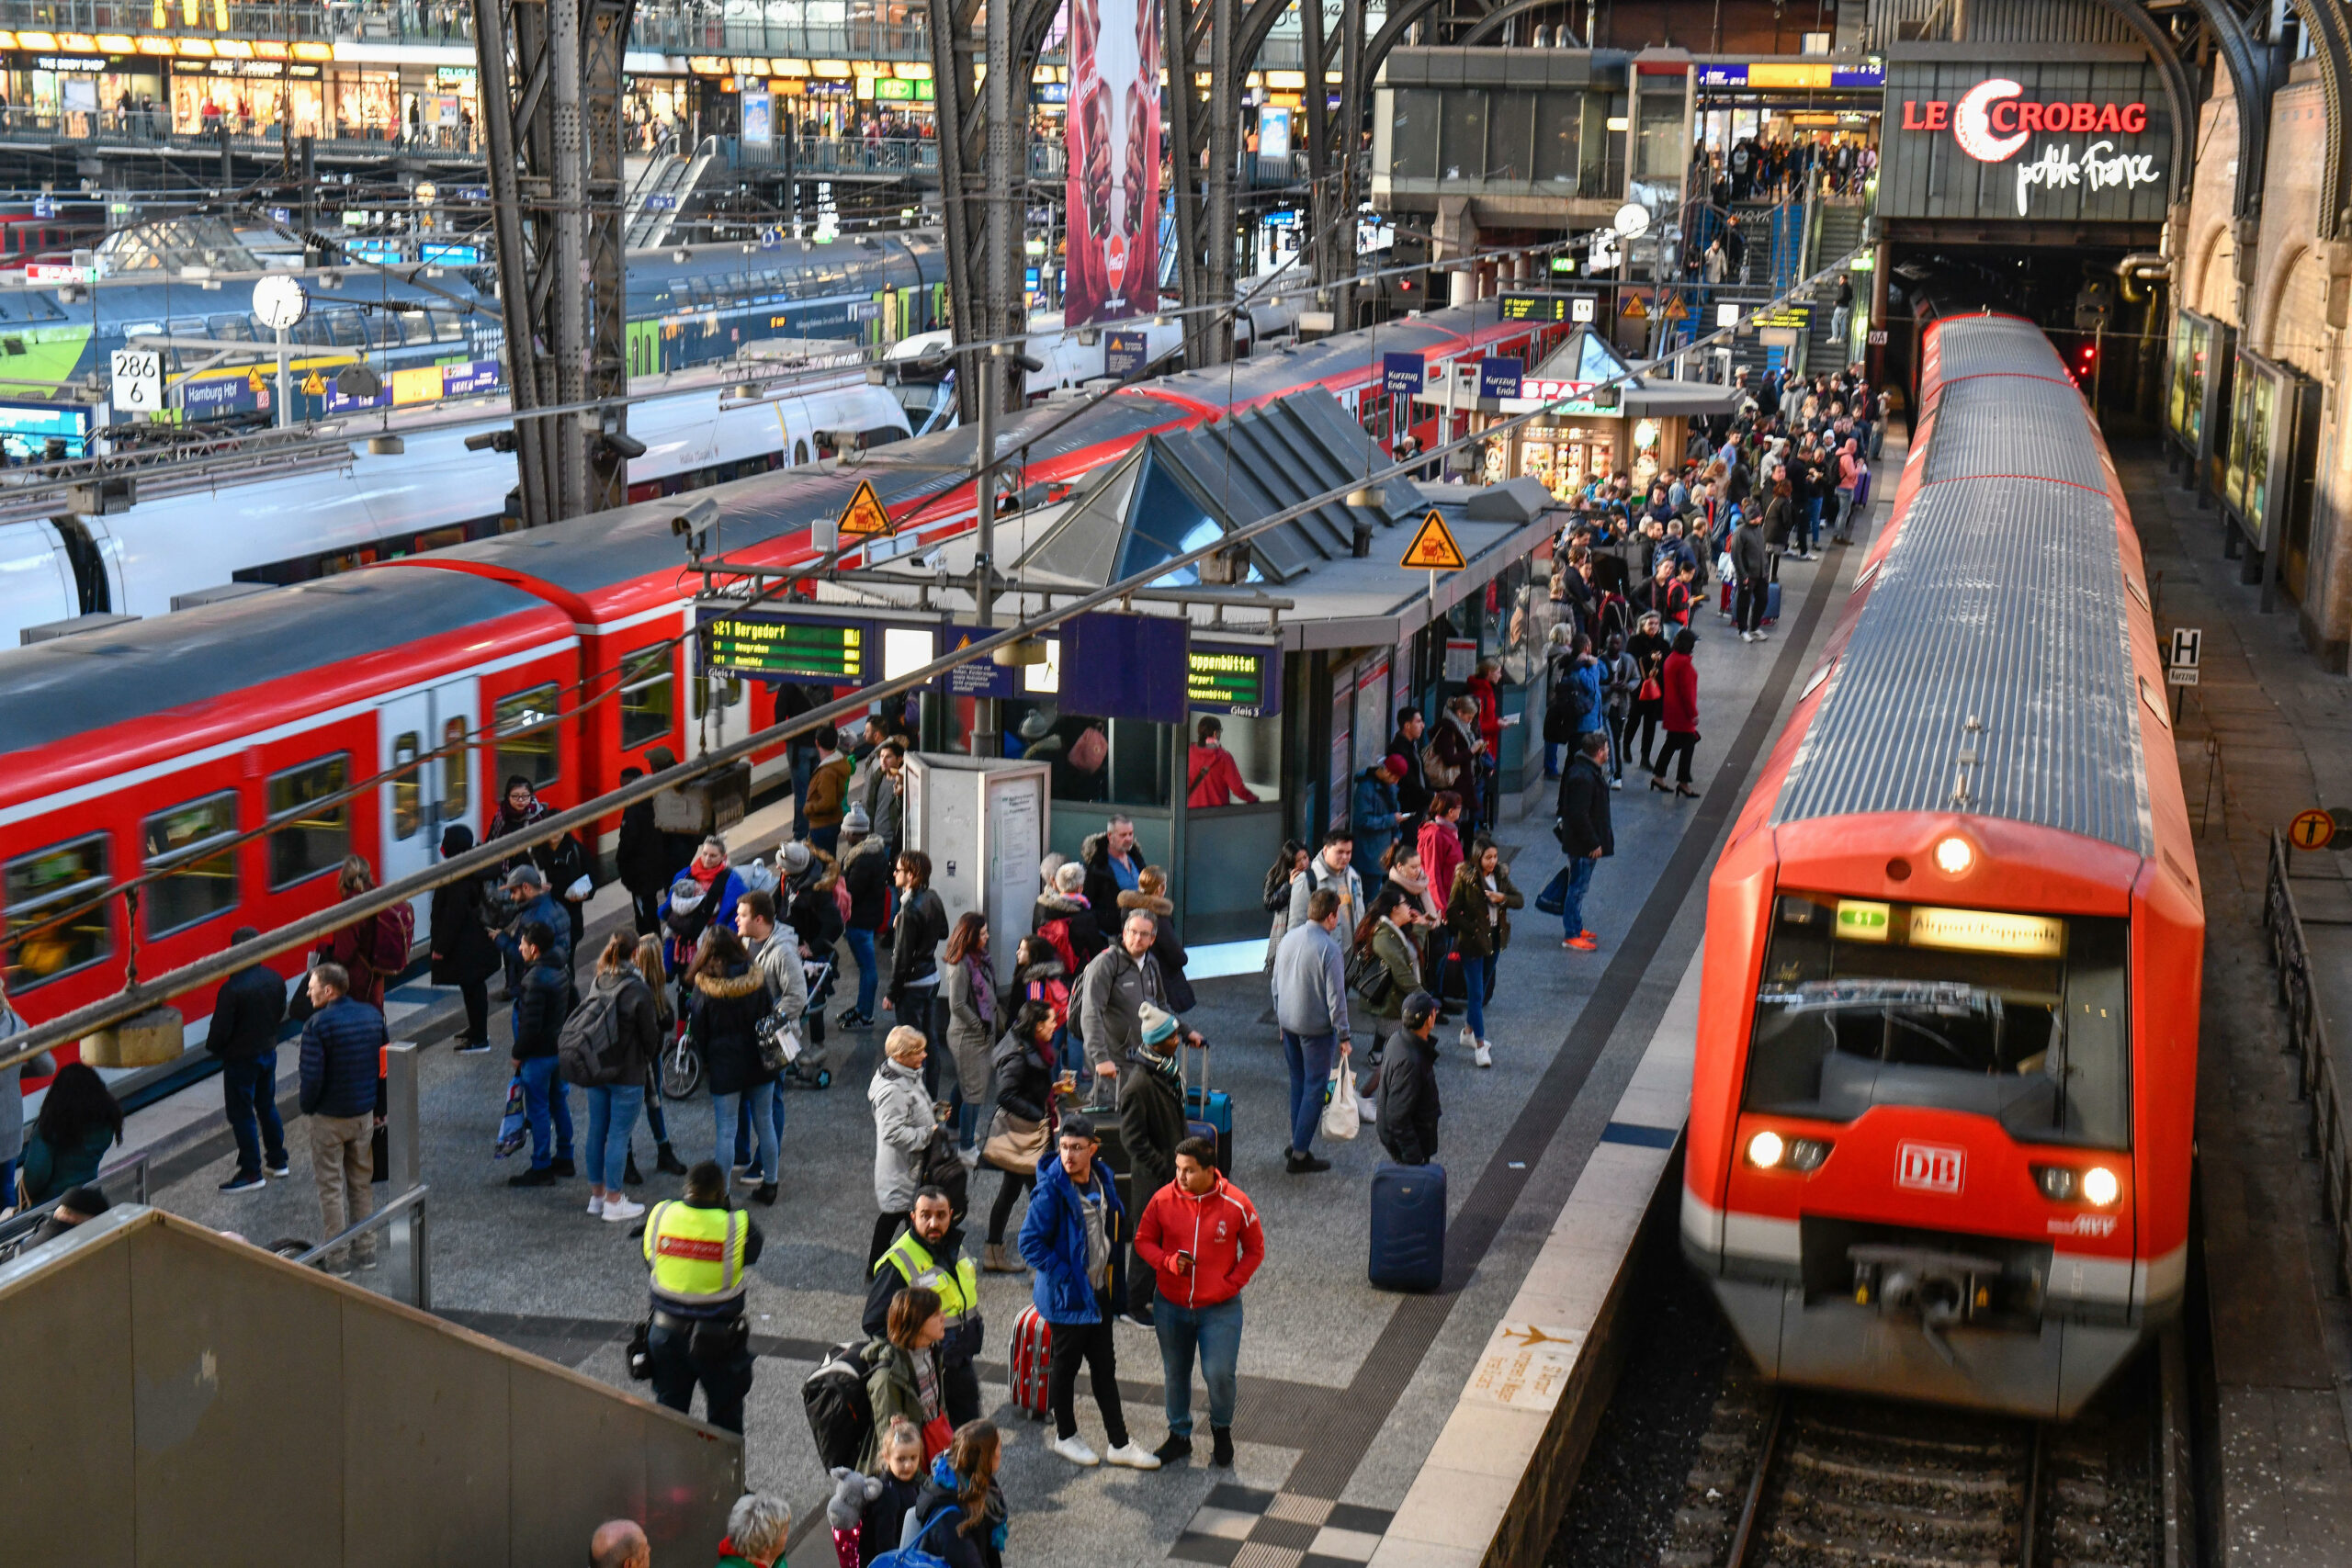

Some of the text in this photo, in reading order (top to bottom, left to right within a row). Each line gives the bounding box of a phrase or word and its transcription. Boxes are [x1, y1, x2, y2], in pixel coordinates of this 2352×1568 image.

[39, 58, 106, 72] THE BODY SHOP
[438, 67, 477, 79] DOUGLA
[1902, 100, 2147, 132] LE CROBAG
[2017, 140, 2160, 217] petite France
[116, 354, 156, 378] 286
[1388, 370, 1419, 382] Kurzzug
[1486, 375, 1516, 387] Kurzzug
[1387, 380, 1407, 390] Ende
[1496, 386, 1516, 396] Ende
[130, 382, 143, 403] 6
[188, 381, 238, 403] Hamburg Hbf
[713, 620, 786, 640] S21 Bergedorf
[735, 642, 770, 654] Neugraben
[2174, 631, 2199, 664] H
[1189, 652, 1256, 672] oppenbüttel
[707, 667, 736, 679] Gleis 4
[1188, 673, 1214, 685] Airport
[2171, 670, 2197, 683] Kurzzug
[1188, 688, 1232, 701] oppenbüttel
[1230, 705, 1260, 717] Gleis 3
[1902, 1146, 1959, 1190] DB
